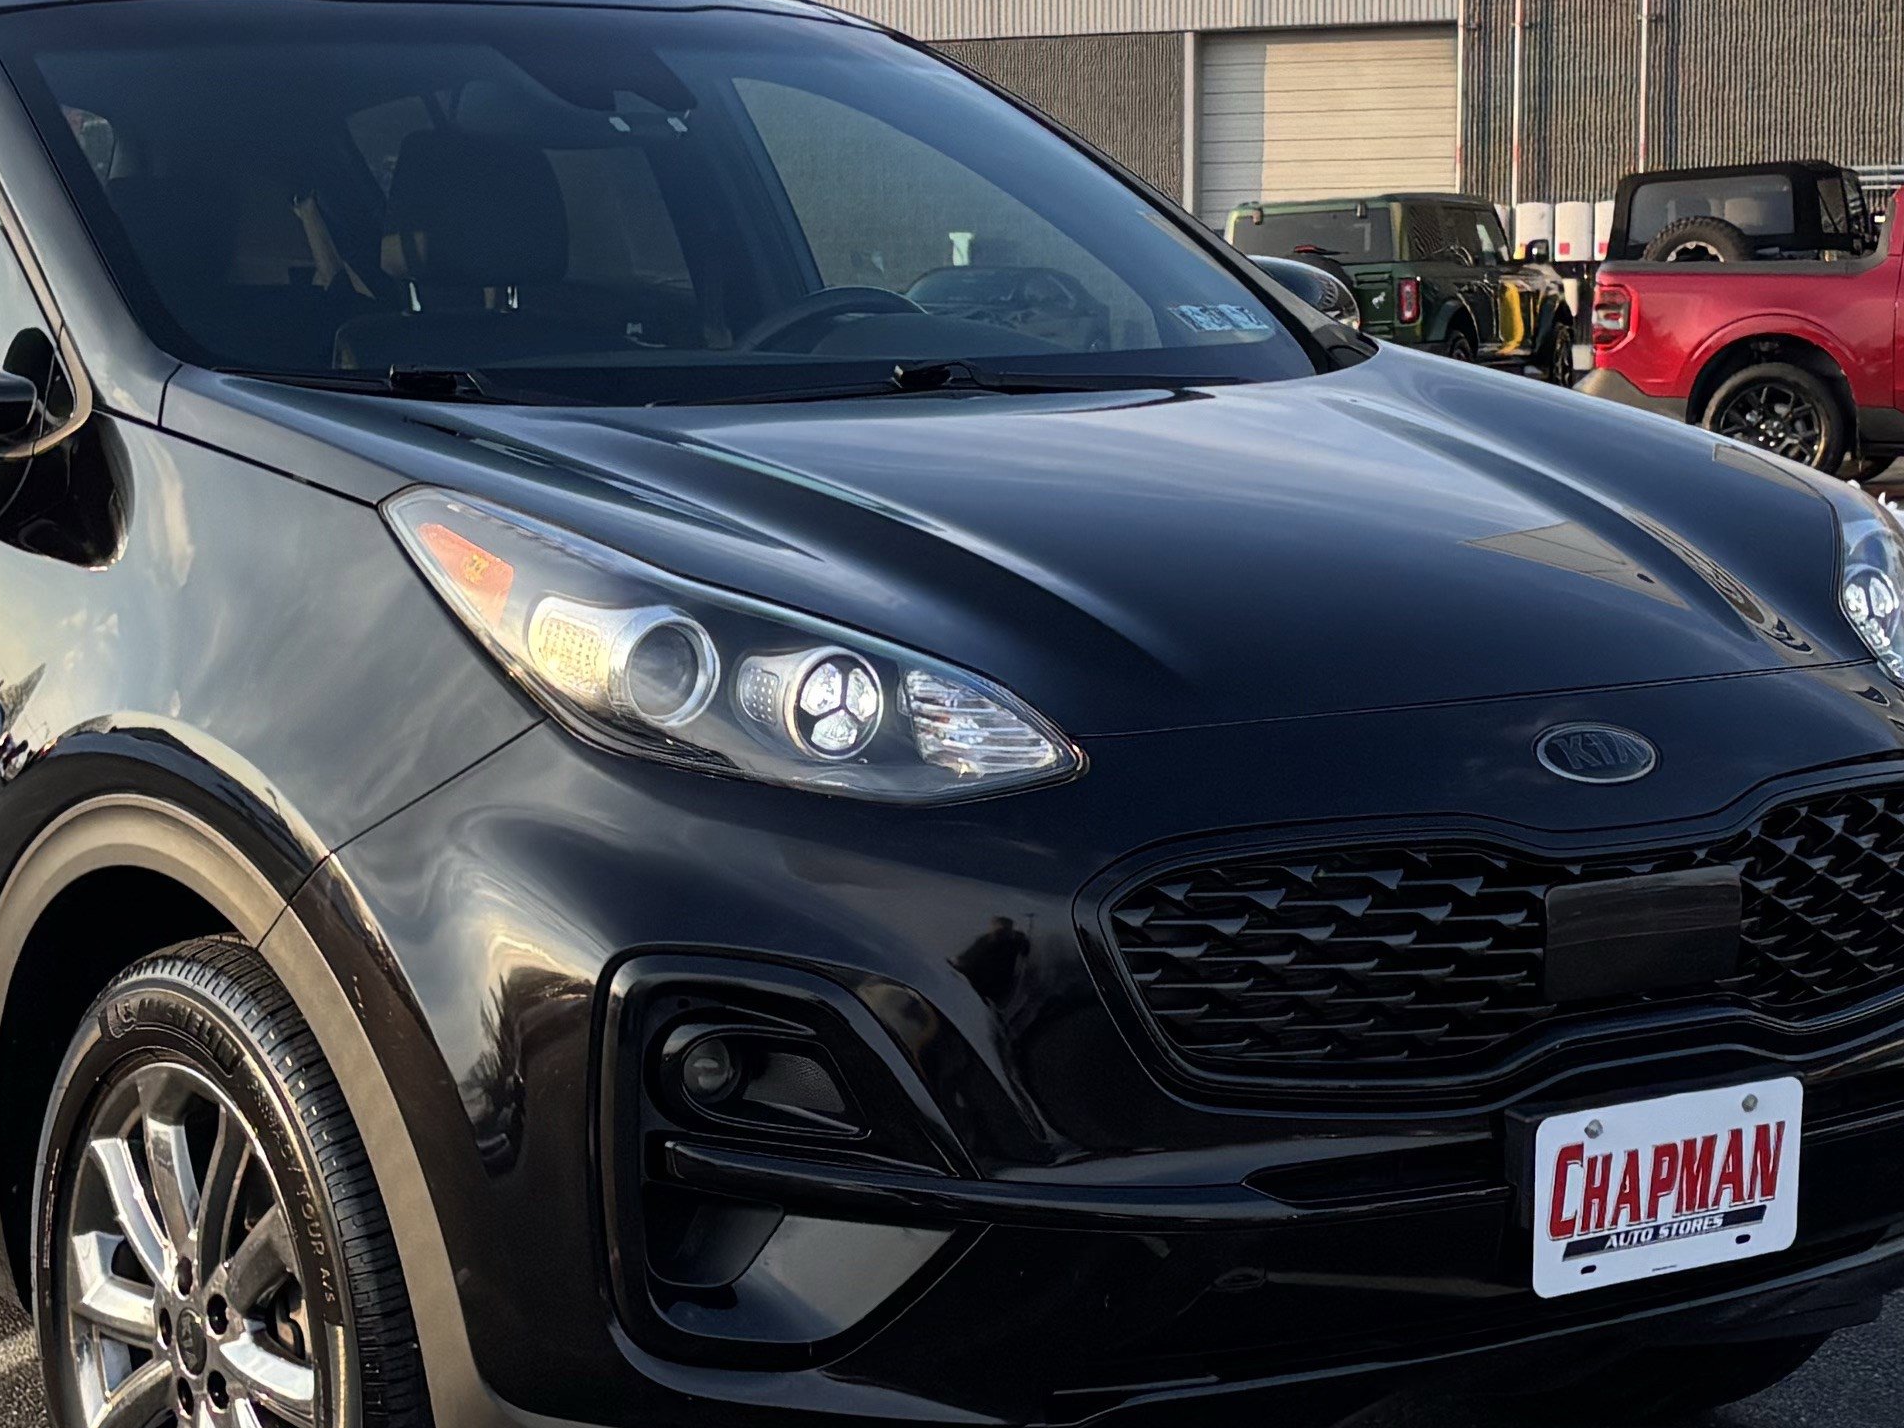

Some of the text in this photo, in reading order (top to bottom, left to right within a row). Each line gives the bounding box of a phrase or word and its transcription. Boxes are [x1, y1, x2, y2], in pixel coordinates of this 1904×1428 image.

[1551, 732, 1650, 771] KIA
[1547, 1119, 1786, 1242] CHAPMAN
[296, 1183, 326, 1257] TOUR
[1603, 1213, 1725, 1250] AUTO STORES
